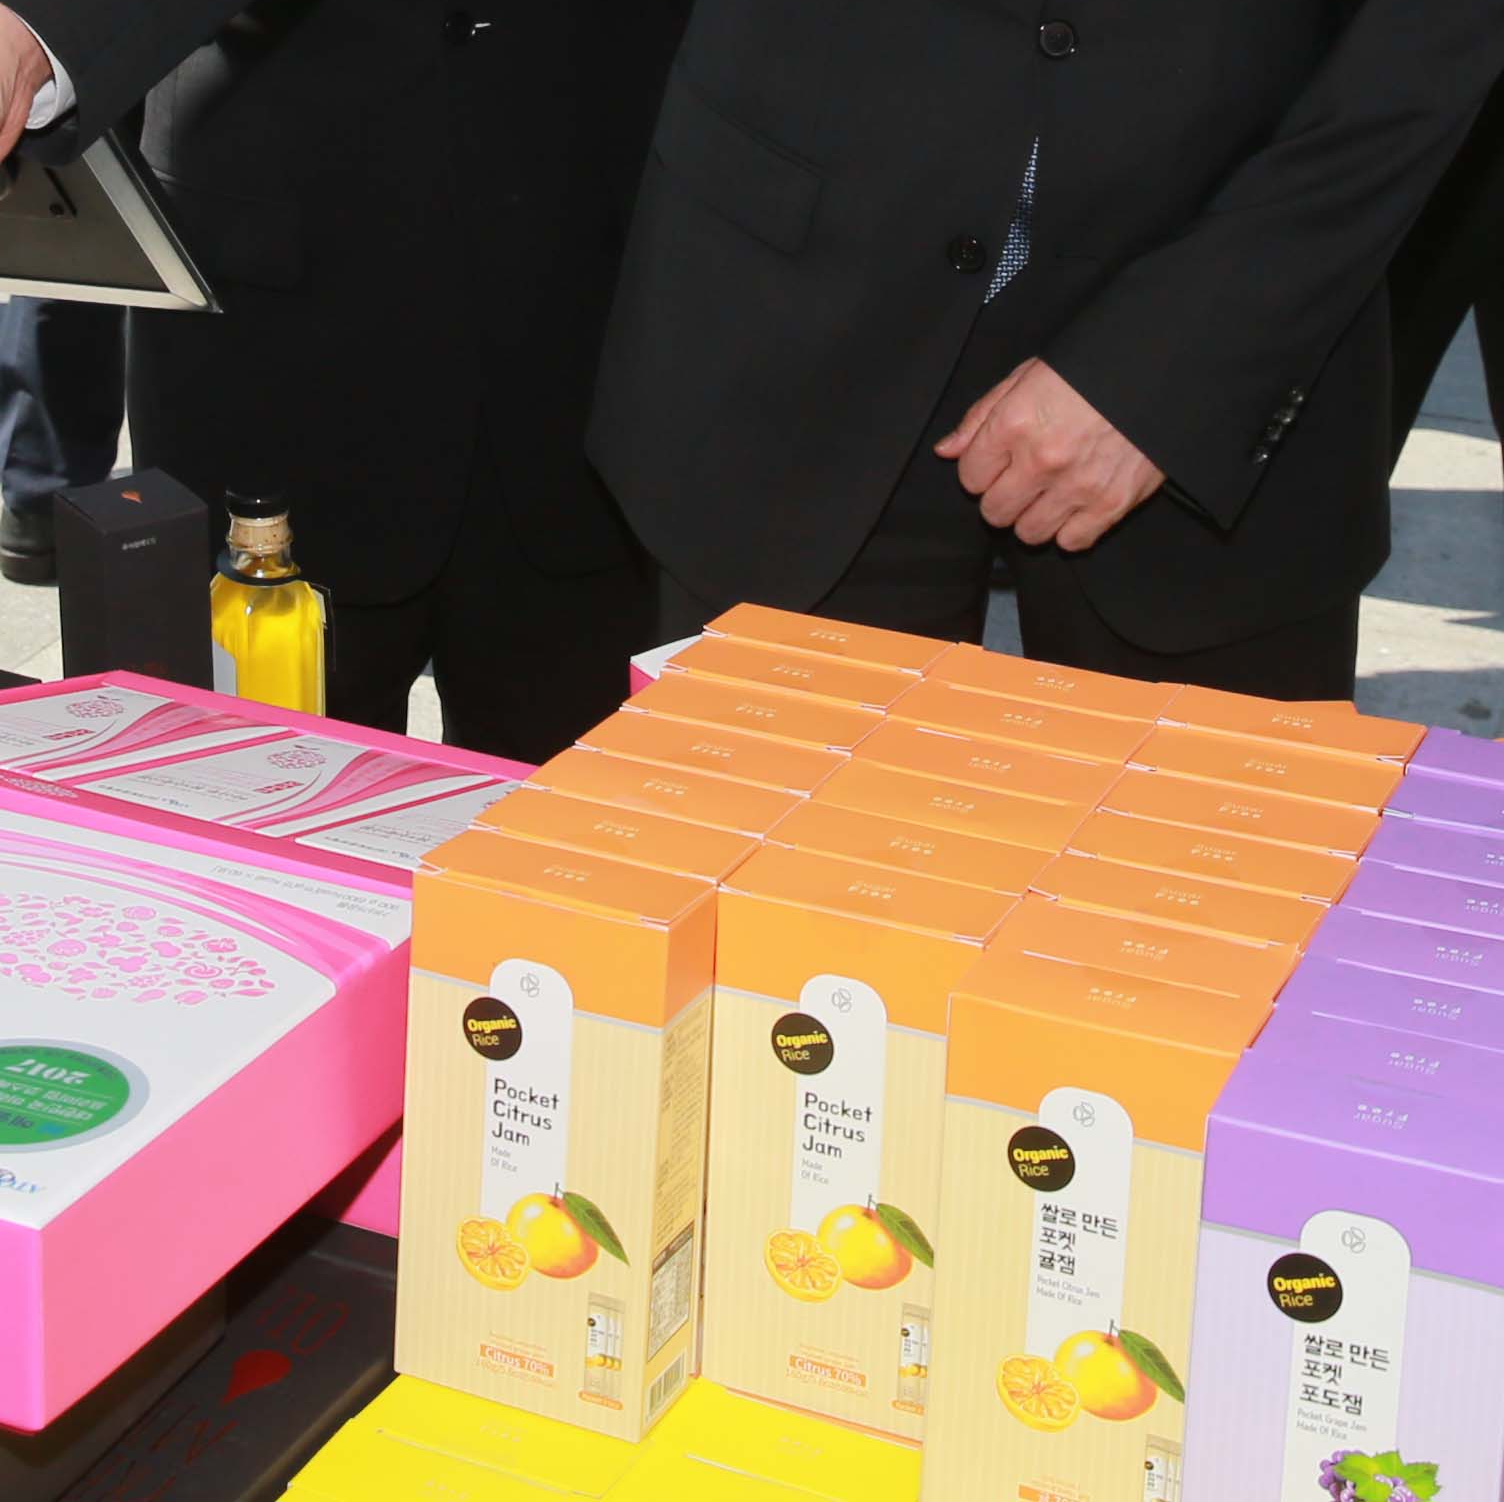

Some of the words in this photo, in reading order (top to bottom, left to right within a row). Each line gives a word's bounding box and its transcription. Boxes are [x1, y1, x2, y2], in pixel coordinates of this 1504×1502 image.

[467, 1016, 516, 1034] Organic
[472, 1032, 500, 1047] Rice
[776, 1031, 828, 1049] Organic
[781, 1047, 810, 1062] Rice
[3, 1058, 90, 1086] 2017
[494, 1077, 560, 1110] Pocket
[492, 1100, 553, 1131] Citrus
[804, 1091, 872, 1123] Pocket
[492, 1121, 531, 1147] Jam
[803, 1113, 866, 1143] Citrus
[802, 1135, 843, 1159] Jam
[1012, 1146, 1069, 1164] Organic
[1018, 1162, 1050, 1178] Rice
[1041, 1202, 1078, 1227] 쌀로
[1082, 1211, 1119, 1239] 만든
[1039, 1227, 1076, 1252] 포켓
[1038, 1249, 1076, 1276] 귤잼
[1273, 1273, 1335, 1293] Organic
[1279, 1291, 1314, 1307] Rice
[485, 1346, 521, 1369] Citrus
[1304, 1333, 1344, 1359] 쌀로
[1349, 1344, 1390, 1372] 만든
[795, 1357, 832, 1378] Citrus
[1301, 1359, 1342, 1386] 포켓
[1299, 1383, 1363, 1415] 포도잼
